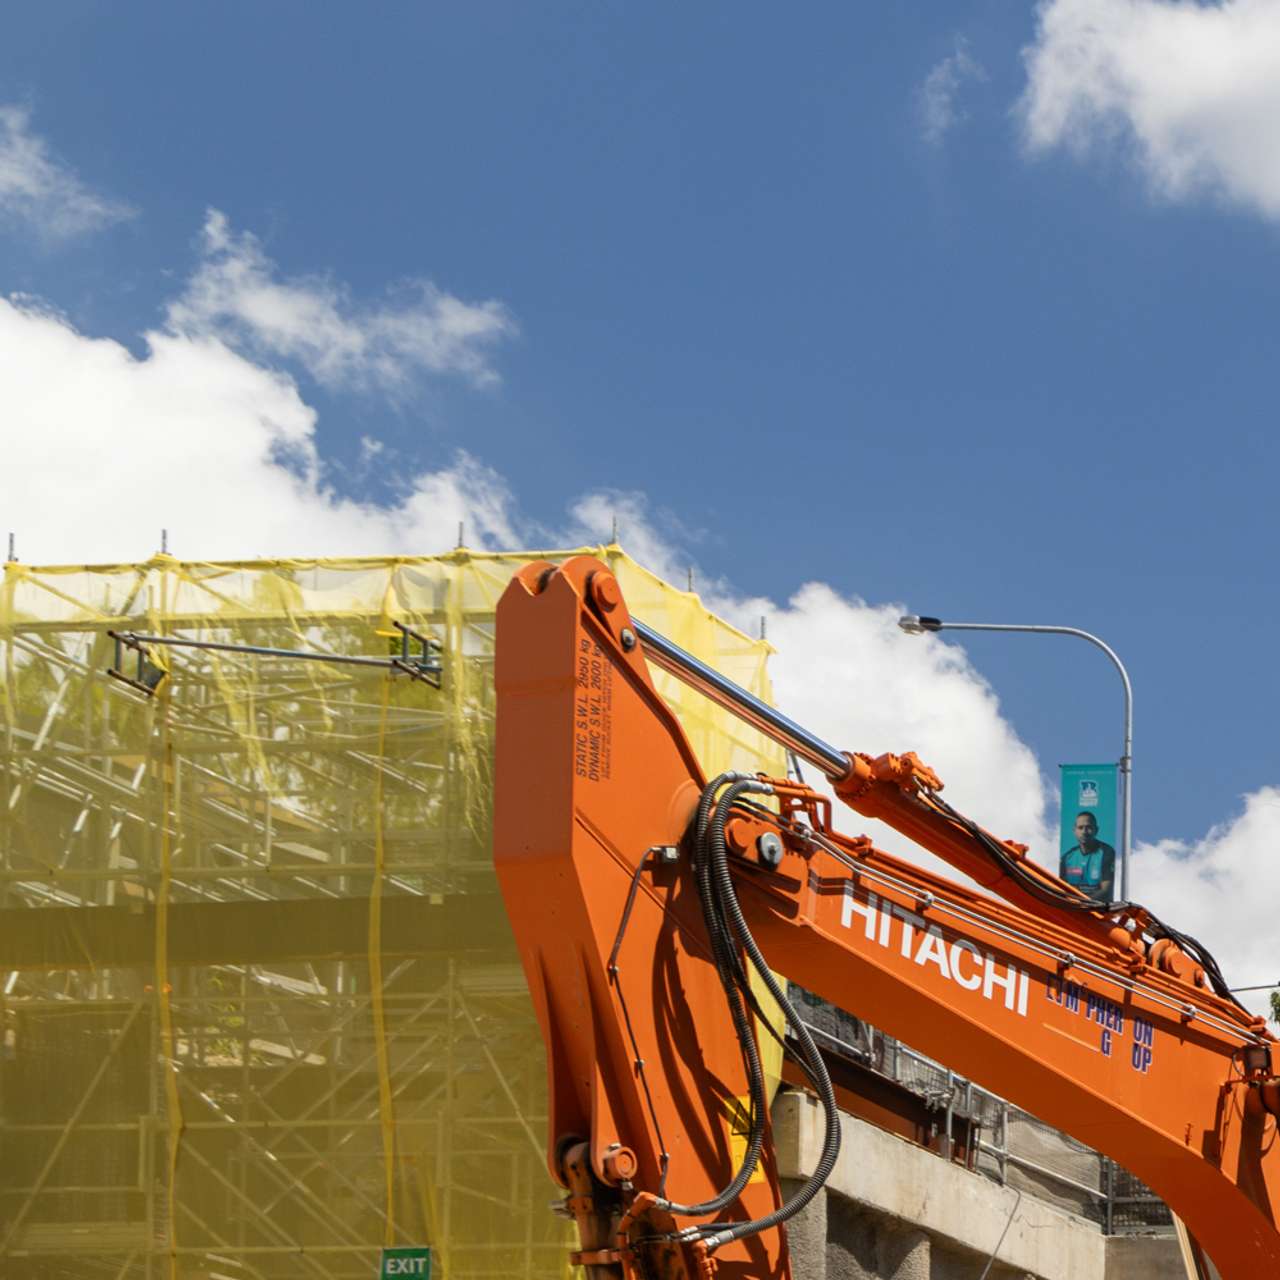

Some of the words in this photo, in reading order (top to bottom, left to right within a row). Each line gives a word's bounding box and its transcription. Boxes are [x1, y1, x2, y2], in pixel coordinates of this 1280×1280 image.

[588, 730, 600, 782] DYNAMIC
[841, 879, 1030, 1017] HITACHI
[386, 1258, 427, 1274] EXIT
